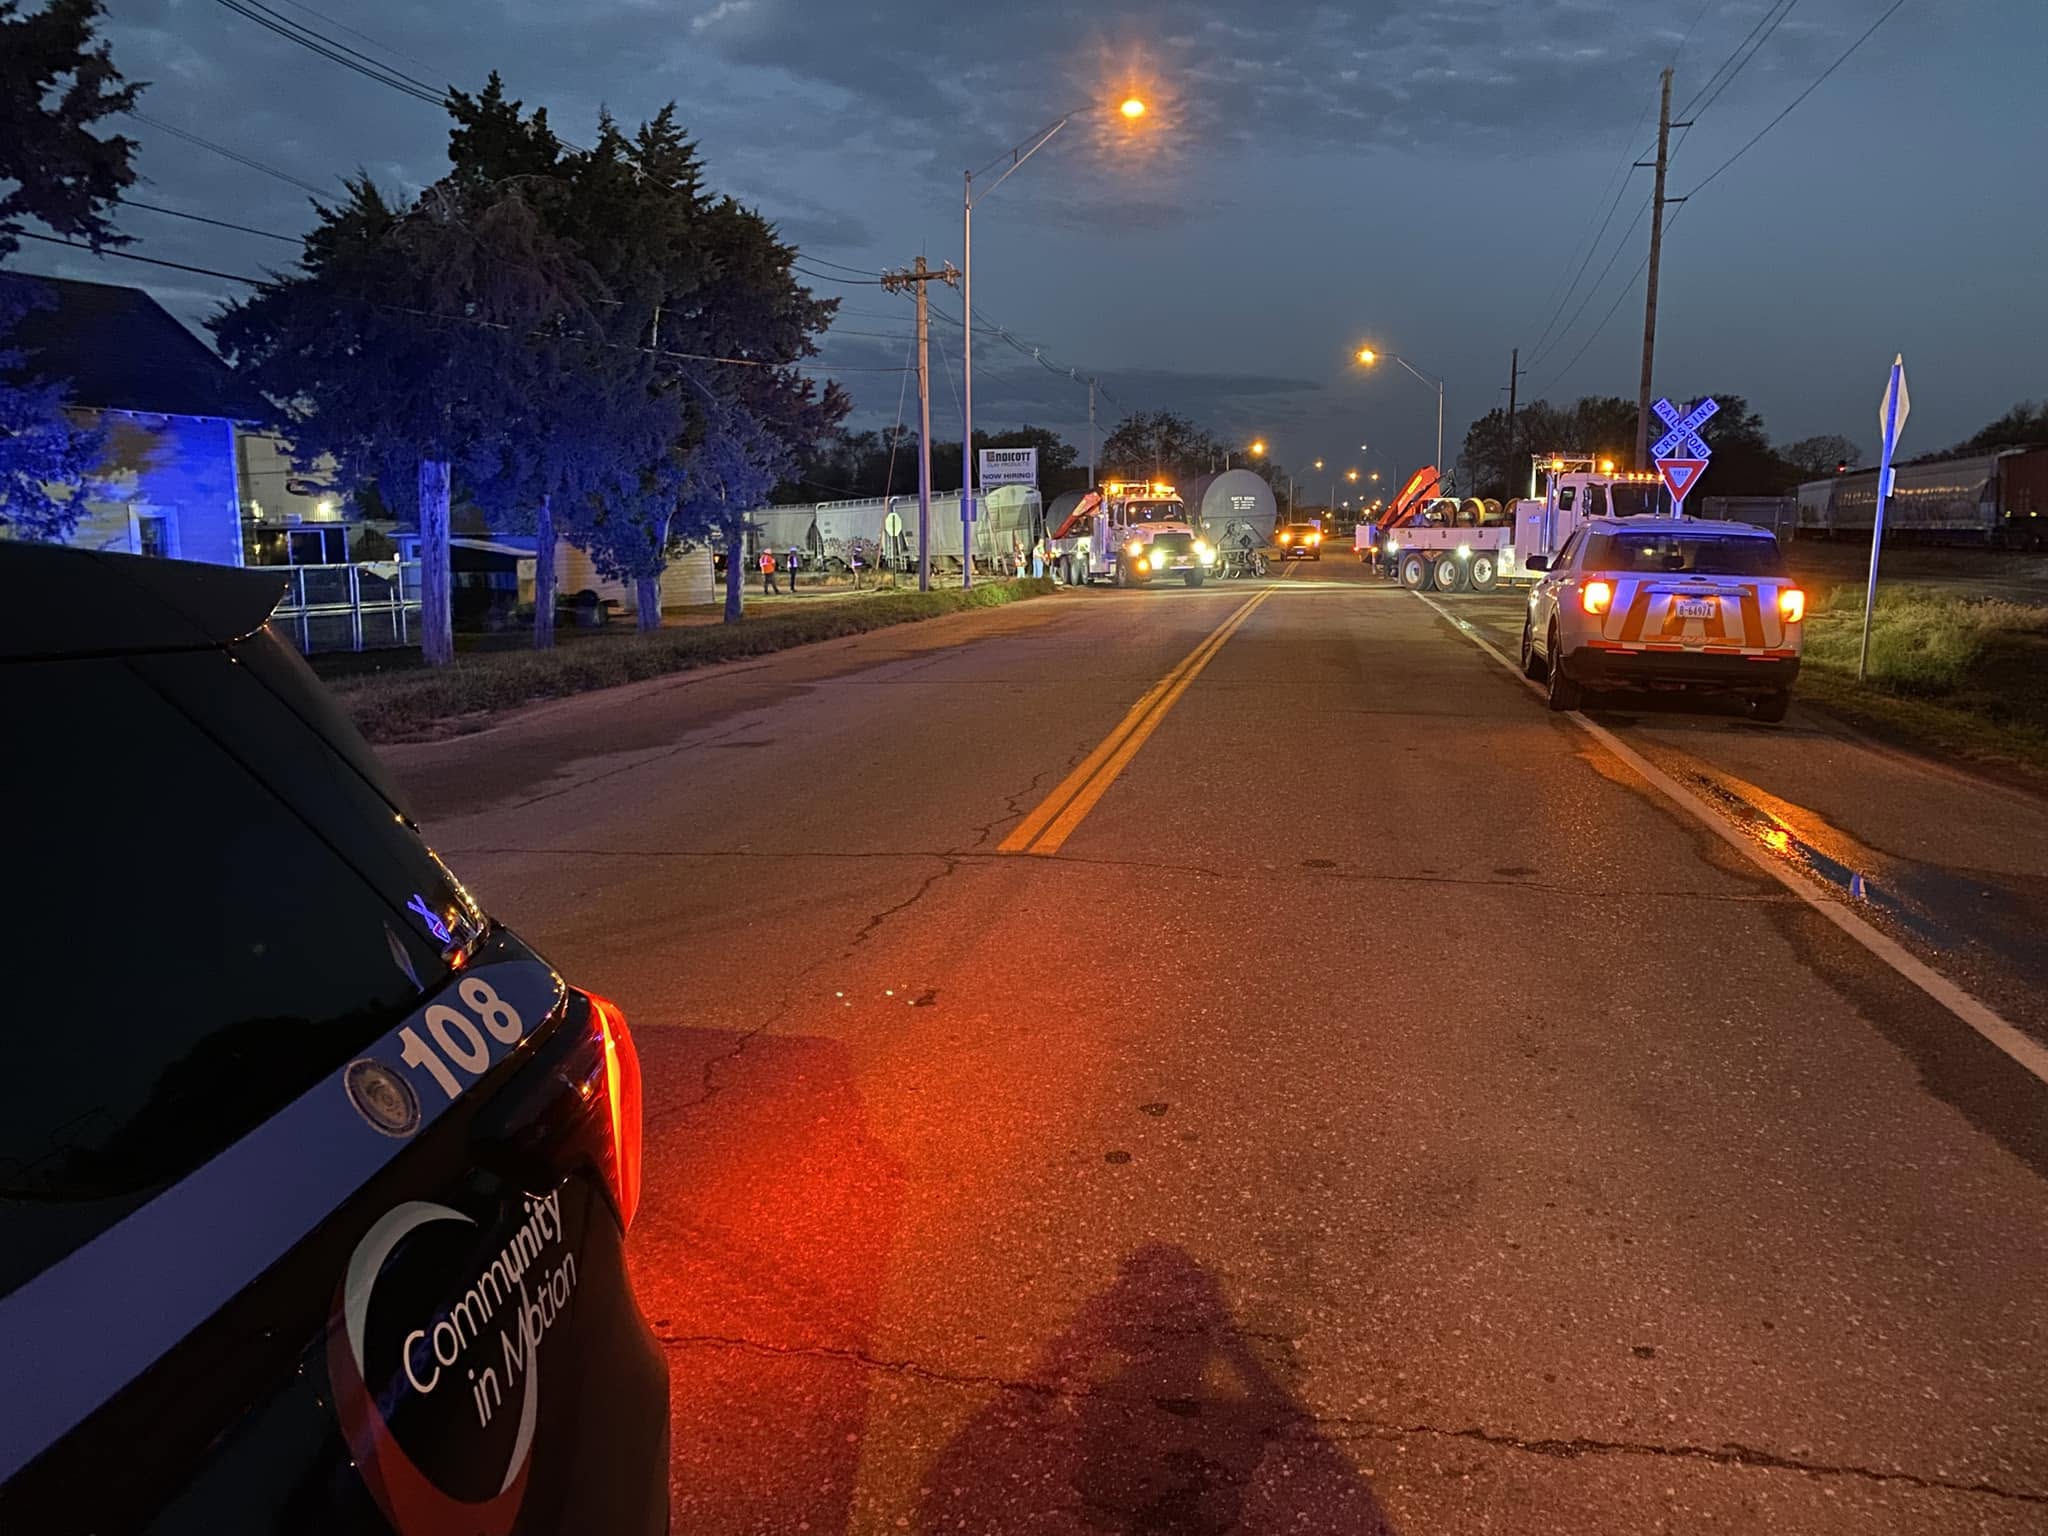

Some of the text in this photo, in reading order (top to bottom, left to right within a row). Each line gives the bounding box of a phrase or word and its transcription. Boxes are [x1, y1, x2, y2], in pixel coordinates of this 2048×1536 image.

[1655, 402, 1715, 455] CROSSING
[399, 976, 524, 1100] 108
[403, 1188, 563, 1395] Community
[467, 1250, 577, 1429] in Motion
